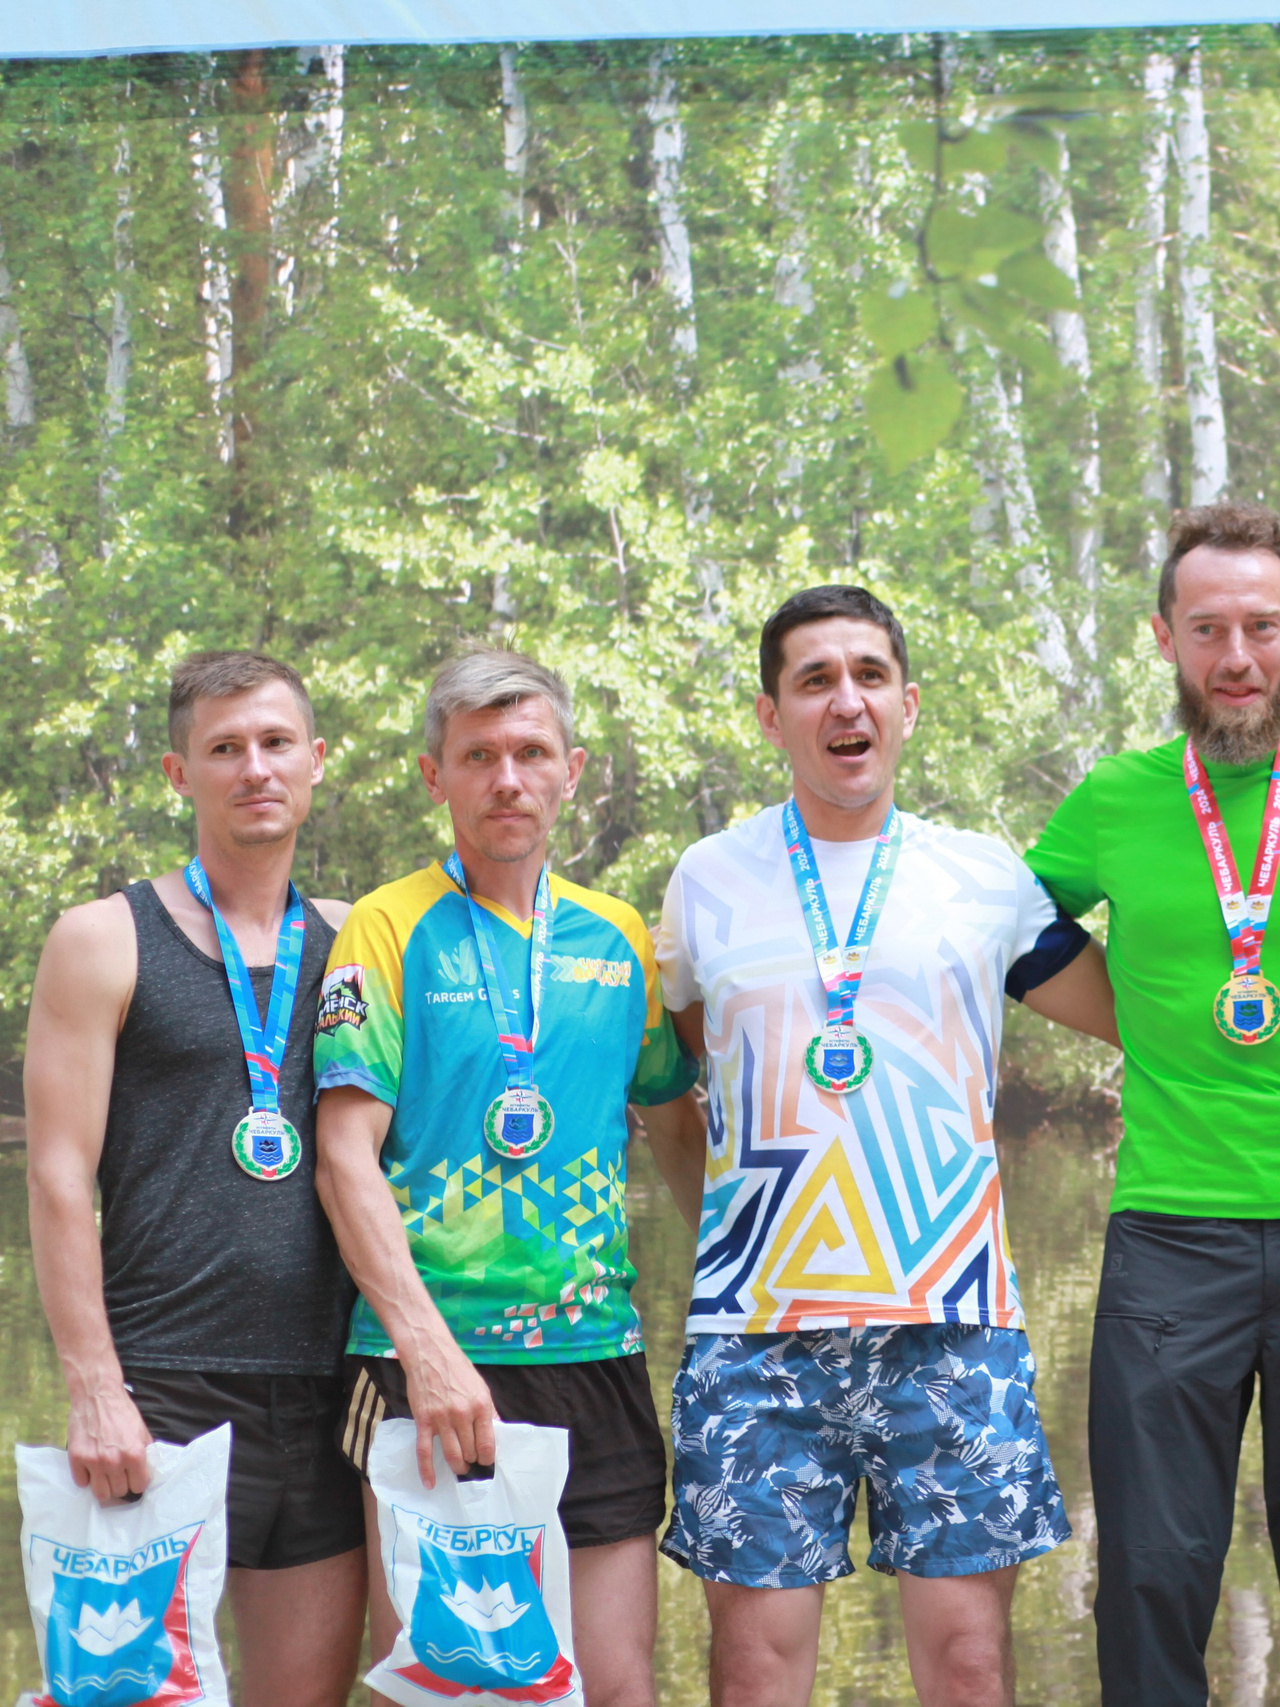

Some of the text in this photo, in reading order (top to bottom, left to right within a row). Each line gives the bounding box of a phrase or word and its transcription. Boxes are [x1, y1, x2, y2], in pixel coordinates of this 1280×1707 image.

[1197, 789, 1212, 815] 2024
[797, 848, 810, 871] 2024
[1207, 821, 1233, 892] ЧЕБАРКУЛЬ
[1258, 816, 1280, 887] ЧЕБАРКУЛЬ
[805, 878, 829, 946] ЧЕБАРКУЛЬ
[854, 876, 882, 941] ЧЕБАРКУЛЬ
[877, 846, 891, 871] 2024
[538, 920, 548, 945] 2024
